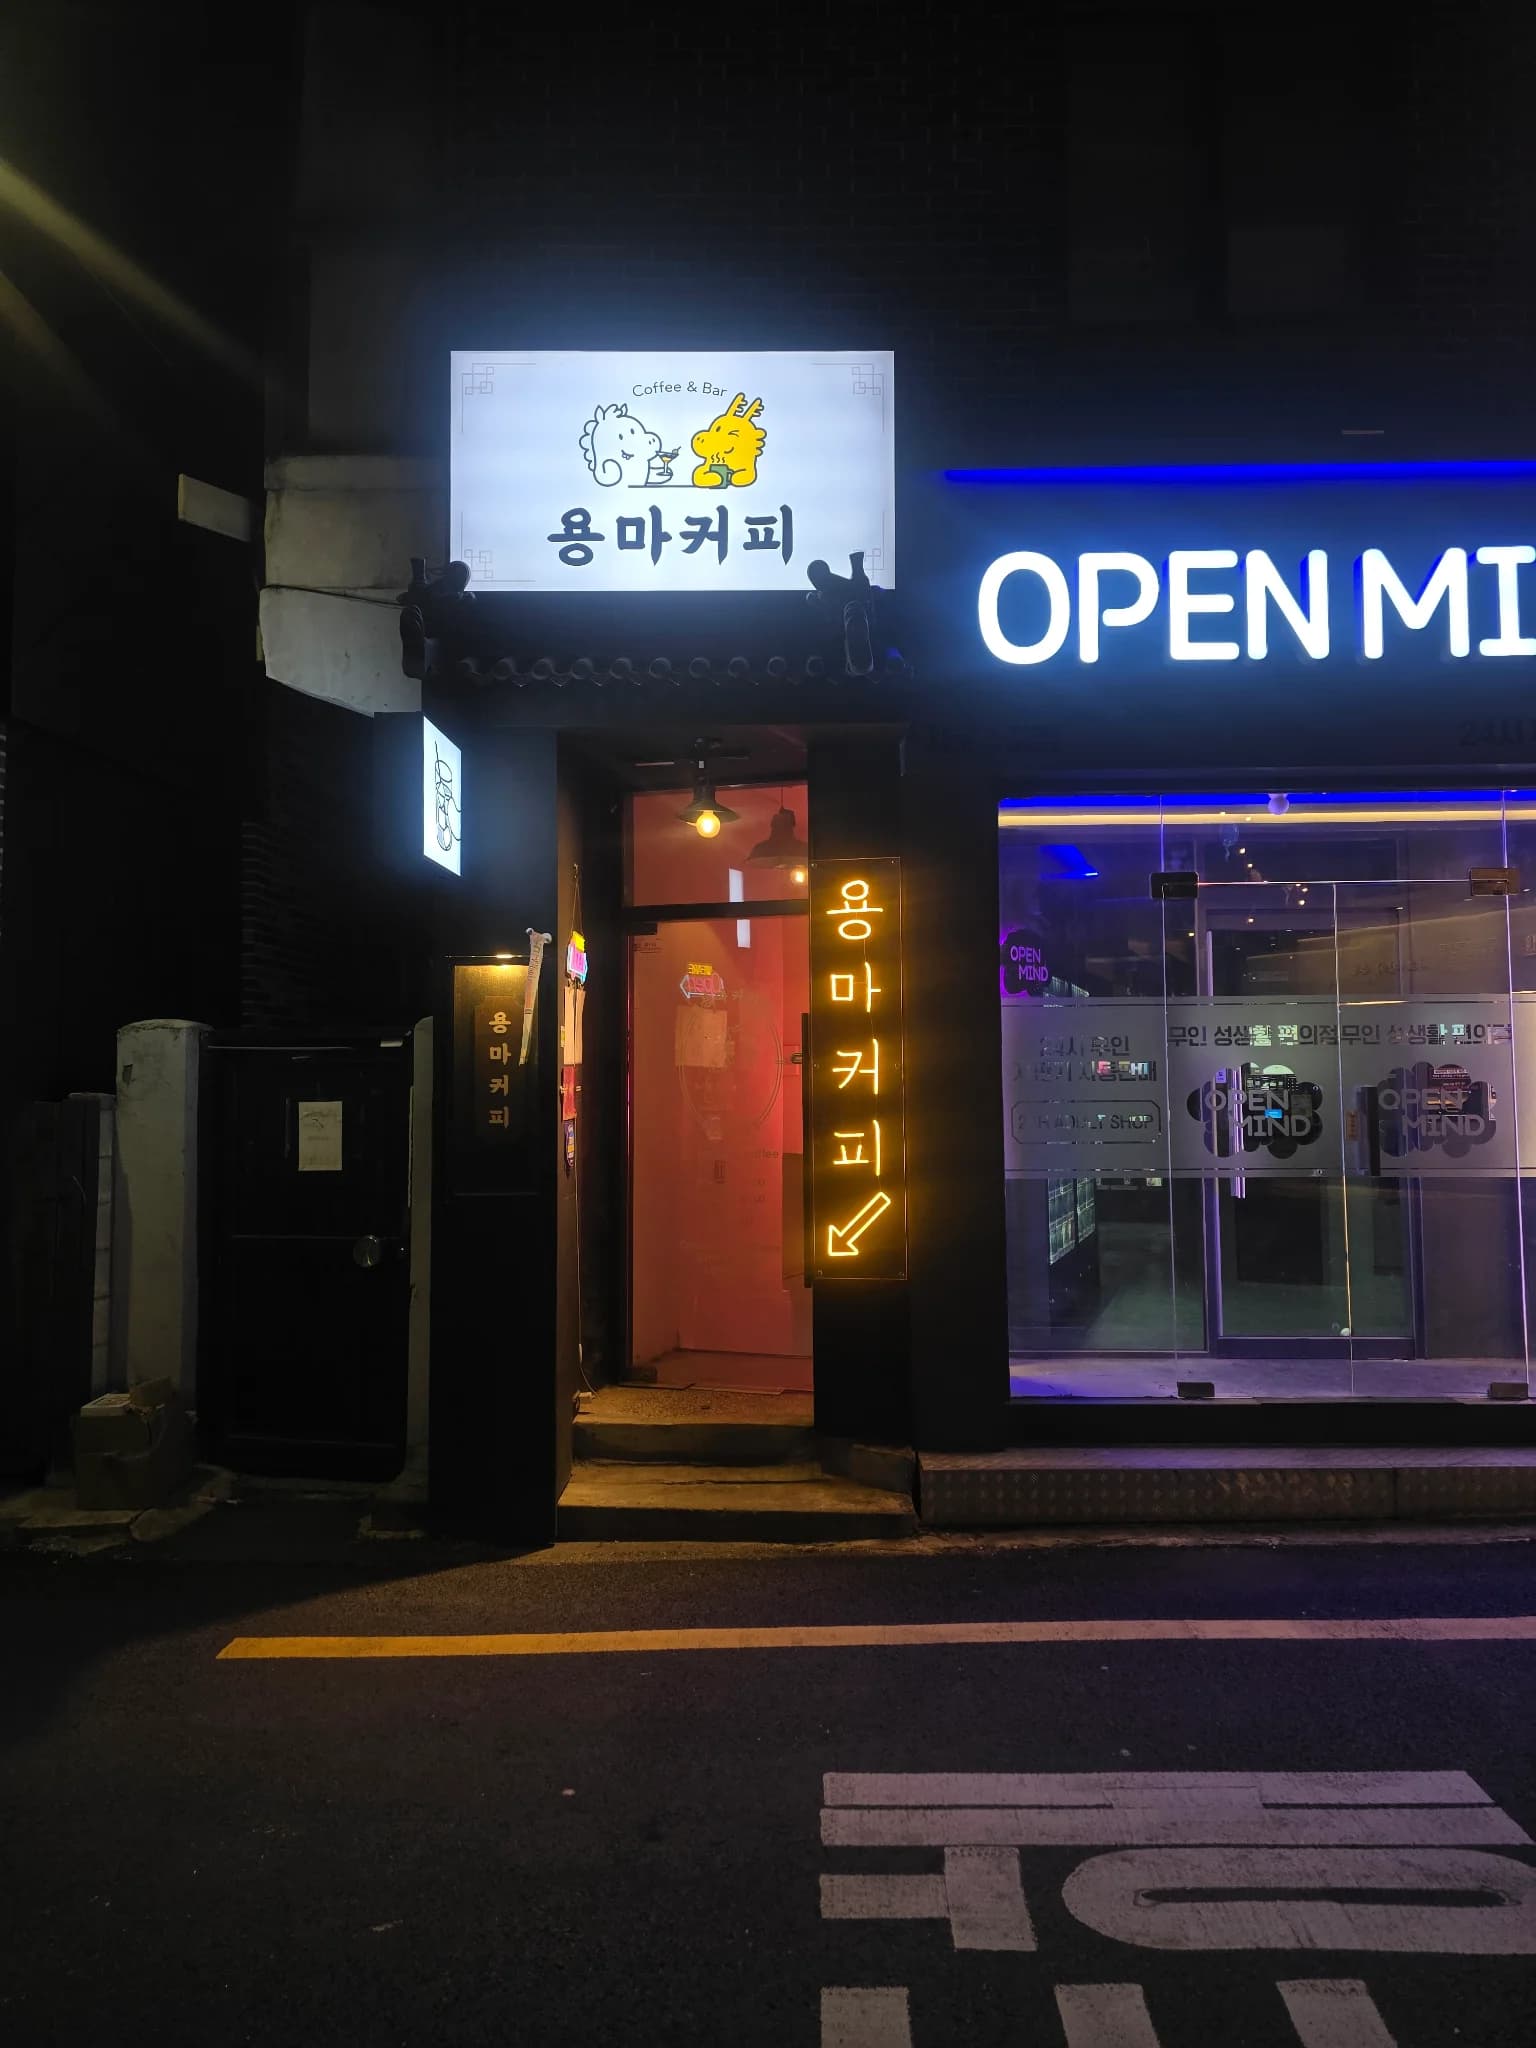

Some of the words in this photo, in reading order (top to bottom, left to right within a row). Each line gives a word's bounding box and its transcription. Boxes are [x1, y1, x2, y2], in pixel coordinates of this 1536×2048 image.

[632, 380, 682, 397] Coffee
[686, 380, 698, 393] &
[702, 381, 728, 397] Bar
[547, 504, 794, 567] 용마커피
[978, 549, 1330, 666] OPEN
[1010, 945, 1041, 963] OPEN
[1018, 964, 1049, 982] MIND
[826, 879, 884, 1178] 용마커피
[1168, 1025, 1207, 1047] 무인
[1340, 1024, 1379, 1045] 무인
[1090, 1035, 1130, 1057] 무인
[488, 1010, 512, 1129] 용마커피
[1204, 1088, 1289, 1111] OPEN
[1377, 1088, 1463, 1111] OPEN
[1110, 1114, 1154, 1130] SHOP
[1229, 1114, 1311, 1137] MIND
[1401, 1114, 1486, 1137] MIND
